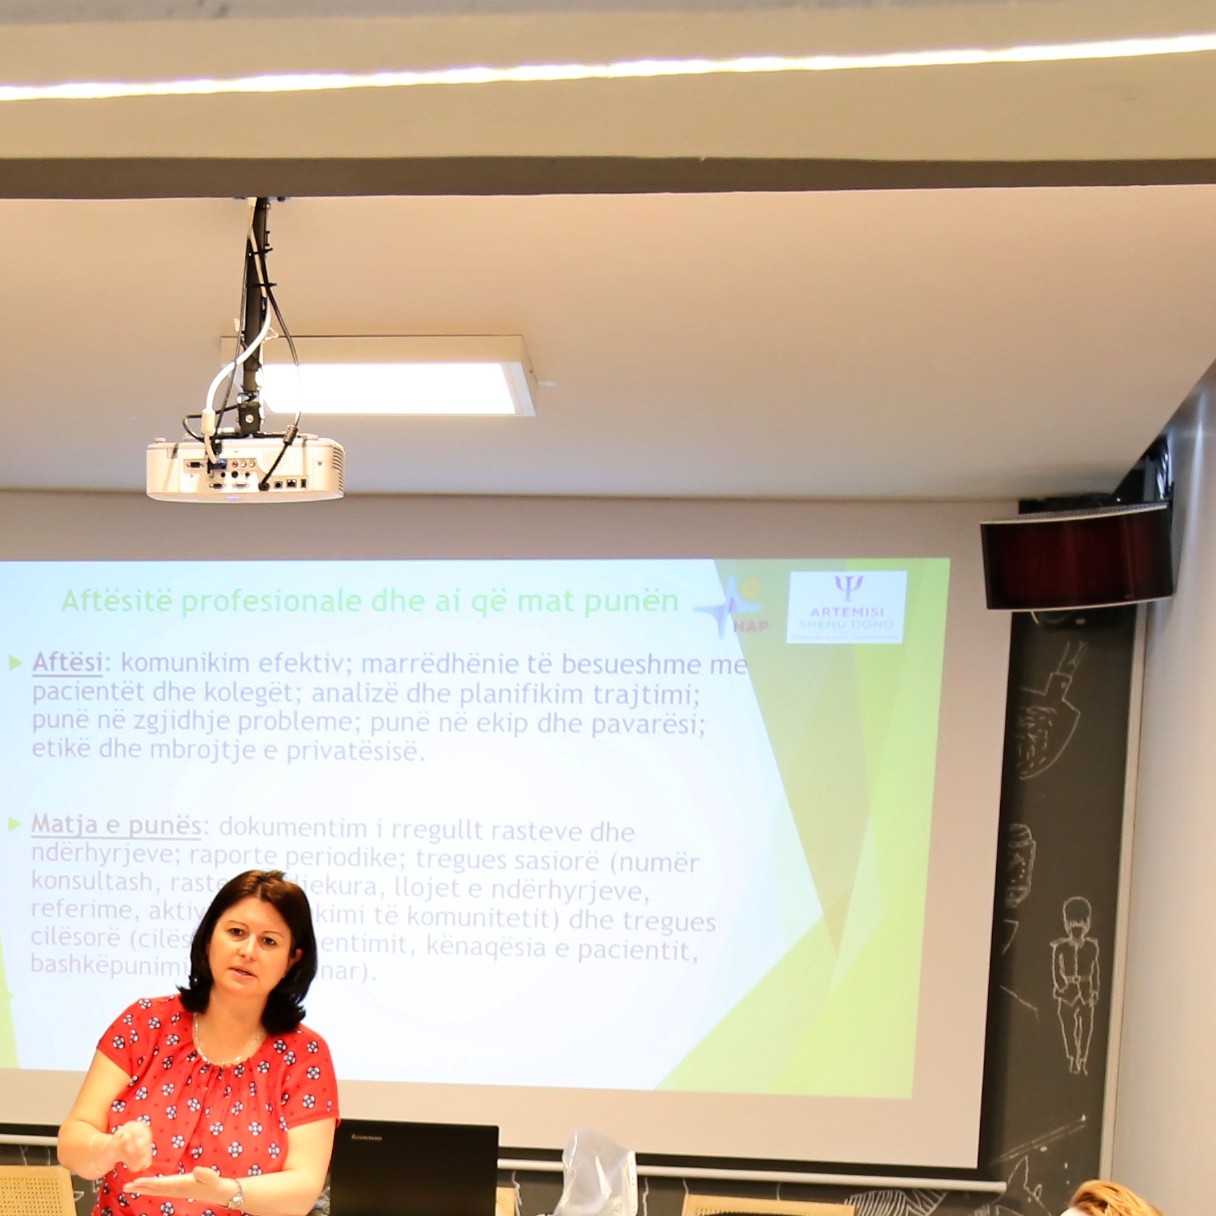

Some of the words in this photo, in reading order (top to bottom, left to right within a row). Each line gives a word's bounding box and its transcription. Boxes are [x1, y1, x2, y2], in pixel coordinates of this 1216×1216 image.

[62, 588, 173, 613] Aftësitë
[181, 588, 362, 619] profesionale
[370, 588, 426, 613] dhe
[435, 589, 460, 613] ai
[471, 589, 506, 619] që
[517, 590, 574, 613] mat
[585, 588, 679, 619] punën
[810, 607, 885, 618] ARTEMISI
[32, 651, 111, 675] Aftësi:
[121, 652, 251, 674] komunikim
[259, 652, 353, 677] efektiv;
[361, 652, 520, 675] marrëdhënie
[527, 654, 553, 675] të
[562, 653, 702, 676] besueshme
[710, 658, 748, 676] me
[32, 681, 144, 707] pacientët
[153, 681, 197, 703] dhe
[204, 681, 302, 708] kolegët;
[311, 682, 399, 704] analizë
[407, 682, 451, 705] dhe
[460, 683, 584, 710] planifikim
[593, 684, 700, 710] trajtimi;
[32, 711, 88, 735] punë
[98, 711, 126, 731] në
[133, 710, 231, 736] zgjidhje
[238, 711, 361, 737] probleme;
[370, 712, 430, 738] punë
[439, 713, 468, 734] në
[476, 713, 528, 738] ekip
[537, 713, 583, 735] dhe
[591, 714, 705, 740] pavarësi;
[32, 738, 91, 759] etikë
[99, 738, 142, 760] dhe
[150, 739, 256, 765] mbrojtje
[264, 745, 277, 761] e
[287, 740, 425, 766] privatësisë.
[31, 813, 99, 838] Matja
[106, 819, 120, 834] e
[129, 814, 209, 839] punës:
[219, 815, 368, 839] dokumentim
[376, 818, 383, 838] i
[392, 819, 484, 845] rregullt
[491, 822, 583, 842] rasteve
[590, 821, 636, 843] dhe
[31, 843, 181, 868] ndërhyrjeve;
[190, 848, 278, 870] raporte
[284, 847, 405, 873] periodike;
[416, 849, 508, 874] tregues
[514, 850, 600, 873] sasiorë
[610, 851, 701, 877] (numër
[31, 871, 161, 894] konsultash,
[395, 875, 460, 903] llojet
[468, 882, 483, 899] e
[491, 877, 651, 906] ndërhyrjeve,
[31, 898, 140, 923] referime,
[149, 899, 207, 921] aktiv
[315, 902, 364, 924] kimi
[374, 904, 399, 926] të
[407, 907, 560, 933] komunitetit)
[569, 909, 614, 932] dhe
[622, 912, 718, 937] tregues
[31, 926, 121, 948] cilësorë
[130, 927, 193, 952] (cilës
[320, 932, 416, 957] entimit,
[426, 935, 546, 961] kënaqësia
[555, 941, 570, 959] e
[577, 939, 699, 965] pacientit,
